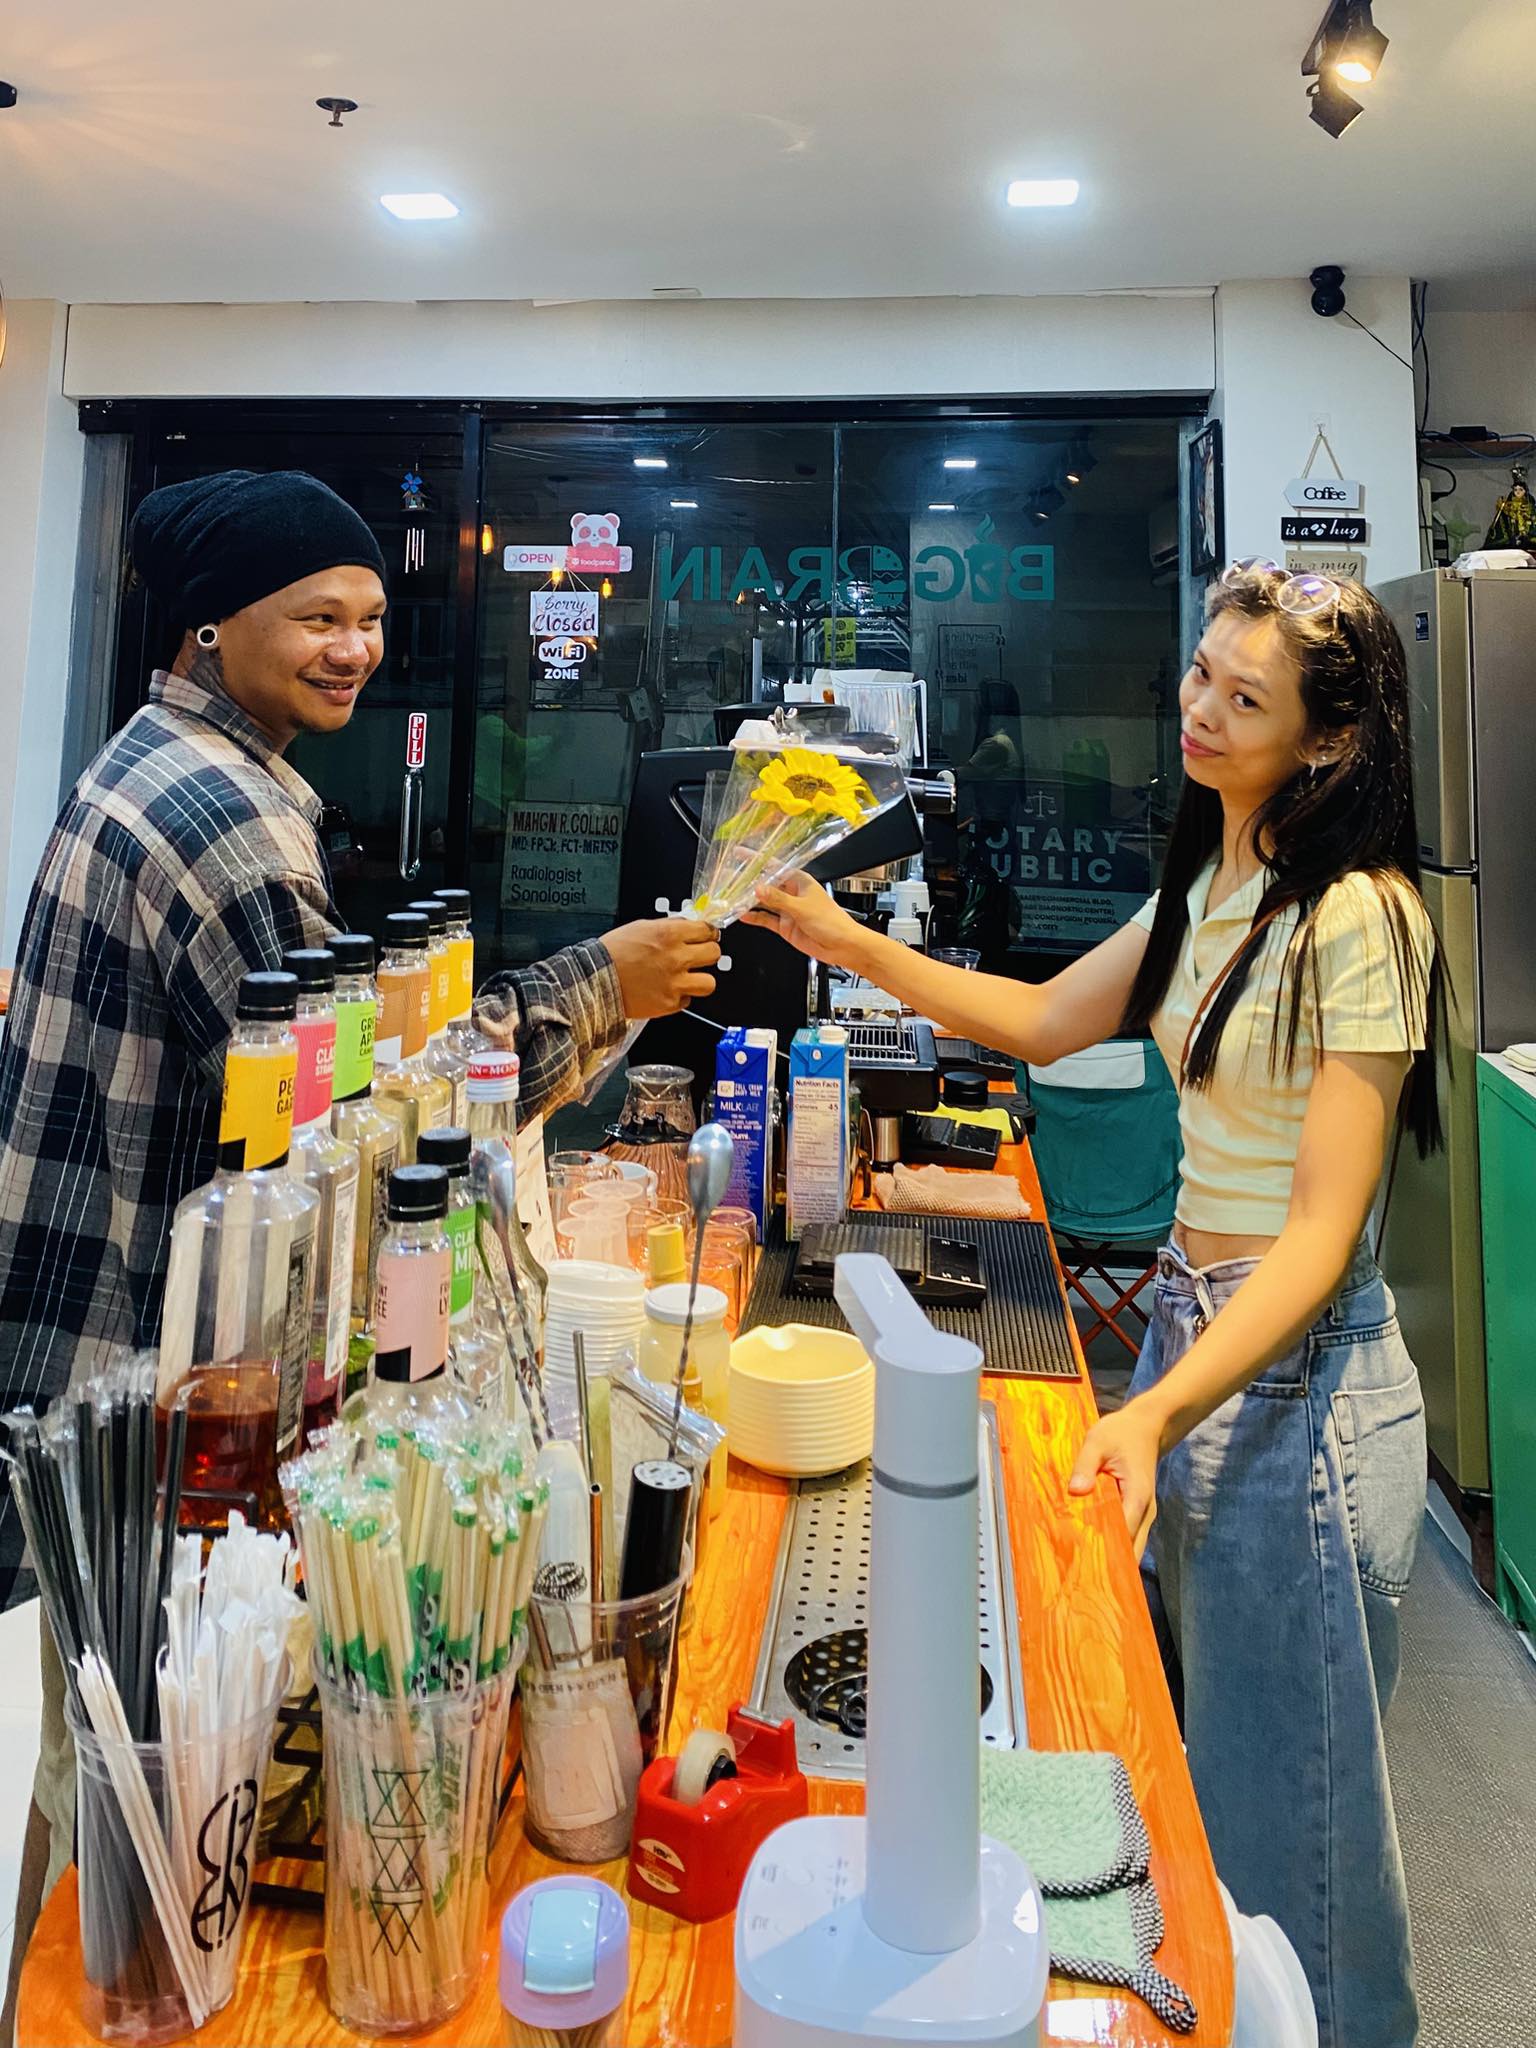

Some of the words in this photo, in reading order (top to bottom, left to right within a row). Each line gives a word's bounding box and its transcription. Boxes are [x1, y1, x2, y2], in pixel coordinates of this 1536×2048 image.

[1304, 486, 1346, 501] Coffee
[1285, 523, 1296, 536] is
[1300, 526, 1309, 536] a
[1329, 518, 1359, 539] hug
[518, 552, 554, 564] OPEN
[579, 558, 616, 568] foodpanda
[1289, 558, 1302, 570] in
[1320, 561, 1358, 577] mug
[533, 613, 596, 632] Closed
[544, 668, 580, 680] ZONE
[410, 716, 424, 764] PULL
[571, 813, 619, 837] COLLAO
[968, 823, 1123, 855] OTARY
[511, 865, 583, 884] Radiologist
[990, 852, 1114, 883] UBLIC
[511, 884, 586, 906] Sonologist
[822, 1081, 840, 1089] Facts
[828, 1103, 839, 1111] 45
[538, 1684, 564, 1694] OPEN
